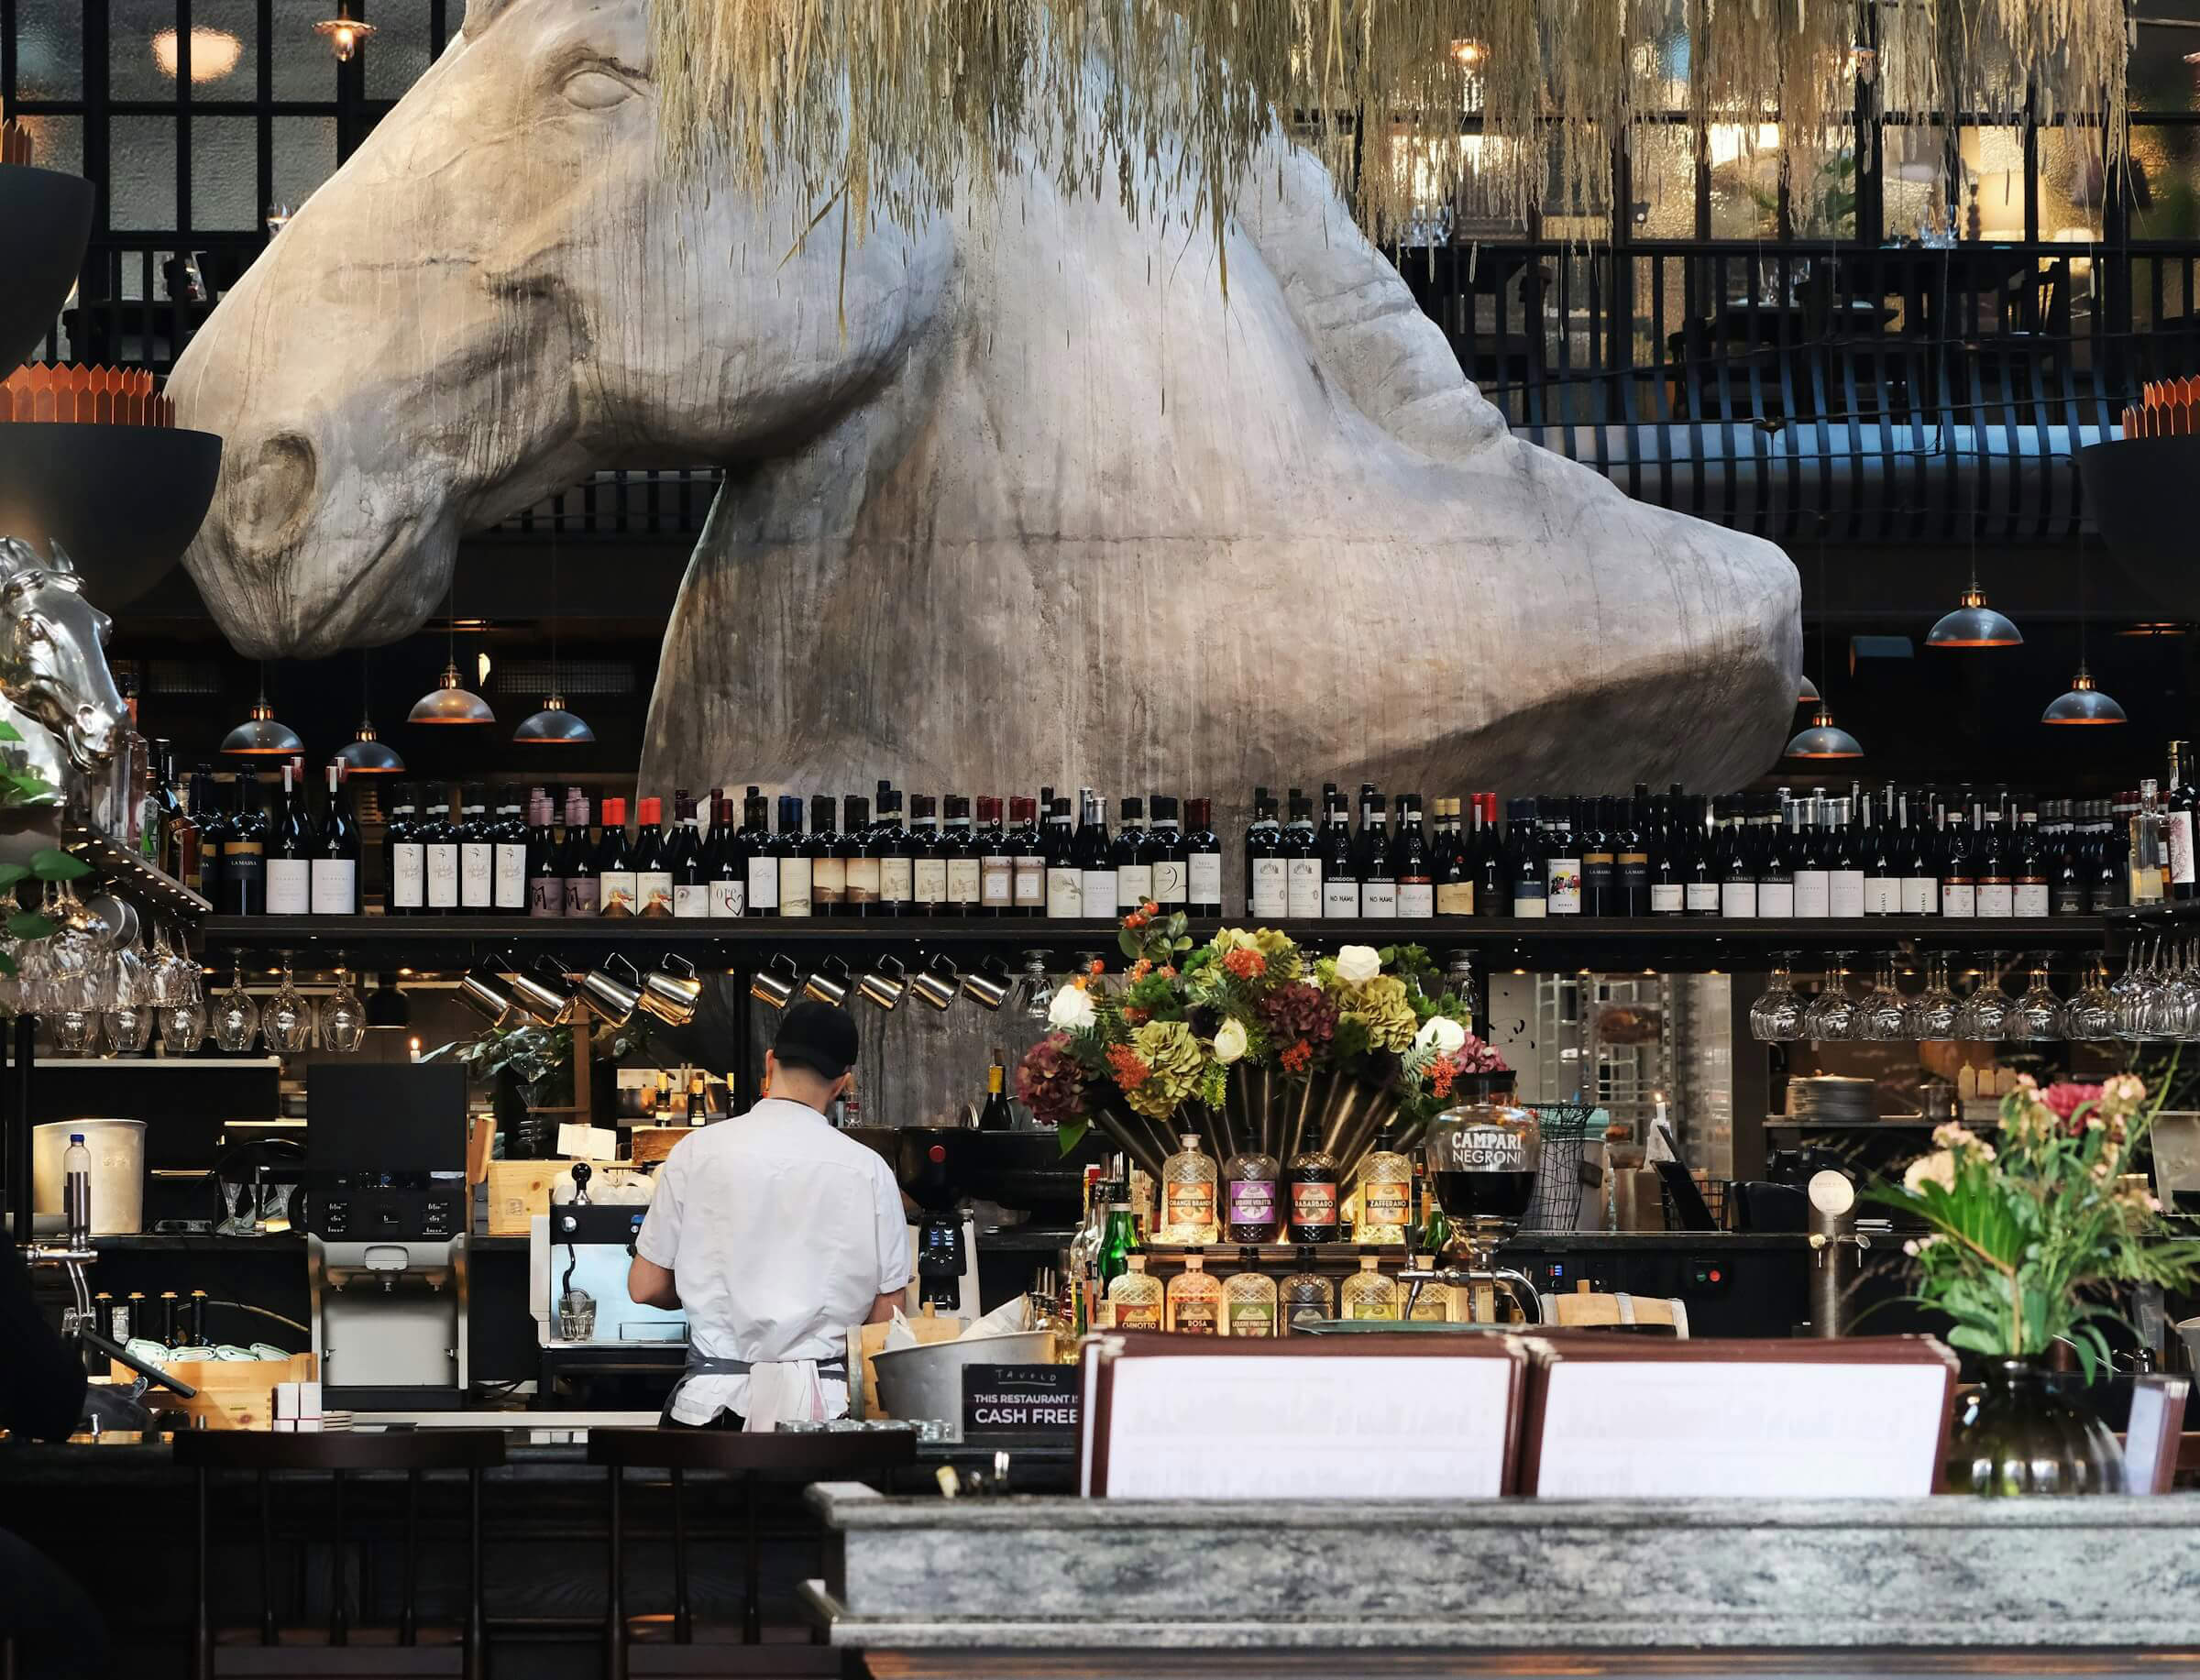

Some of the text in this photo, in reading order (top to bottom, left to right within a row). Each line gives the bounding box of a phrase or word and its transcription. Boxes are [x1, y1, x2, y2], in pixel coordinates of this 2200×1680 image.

[1452, 1132, 1522, 1149] CAMPARI
[1453, 1149, 1521, 1164] NEGRONI
[1294, 1200, 1334, 1208] RABARBARO
[974, 1394, 998, 1403] THIS
[1000, 1394, 1070, 1403] RESTAURANT
[974, 1408, 1078, 1423] CASH FREE
